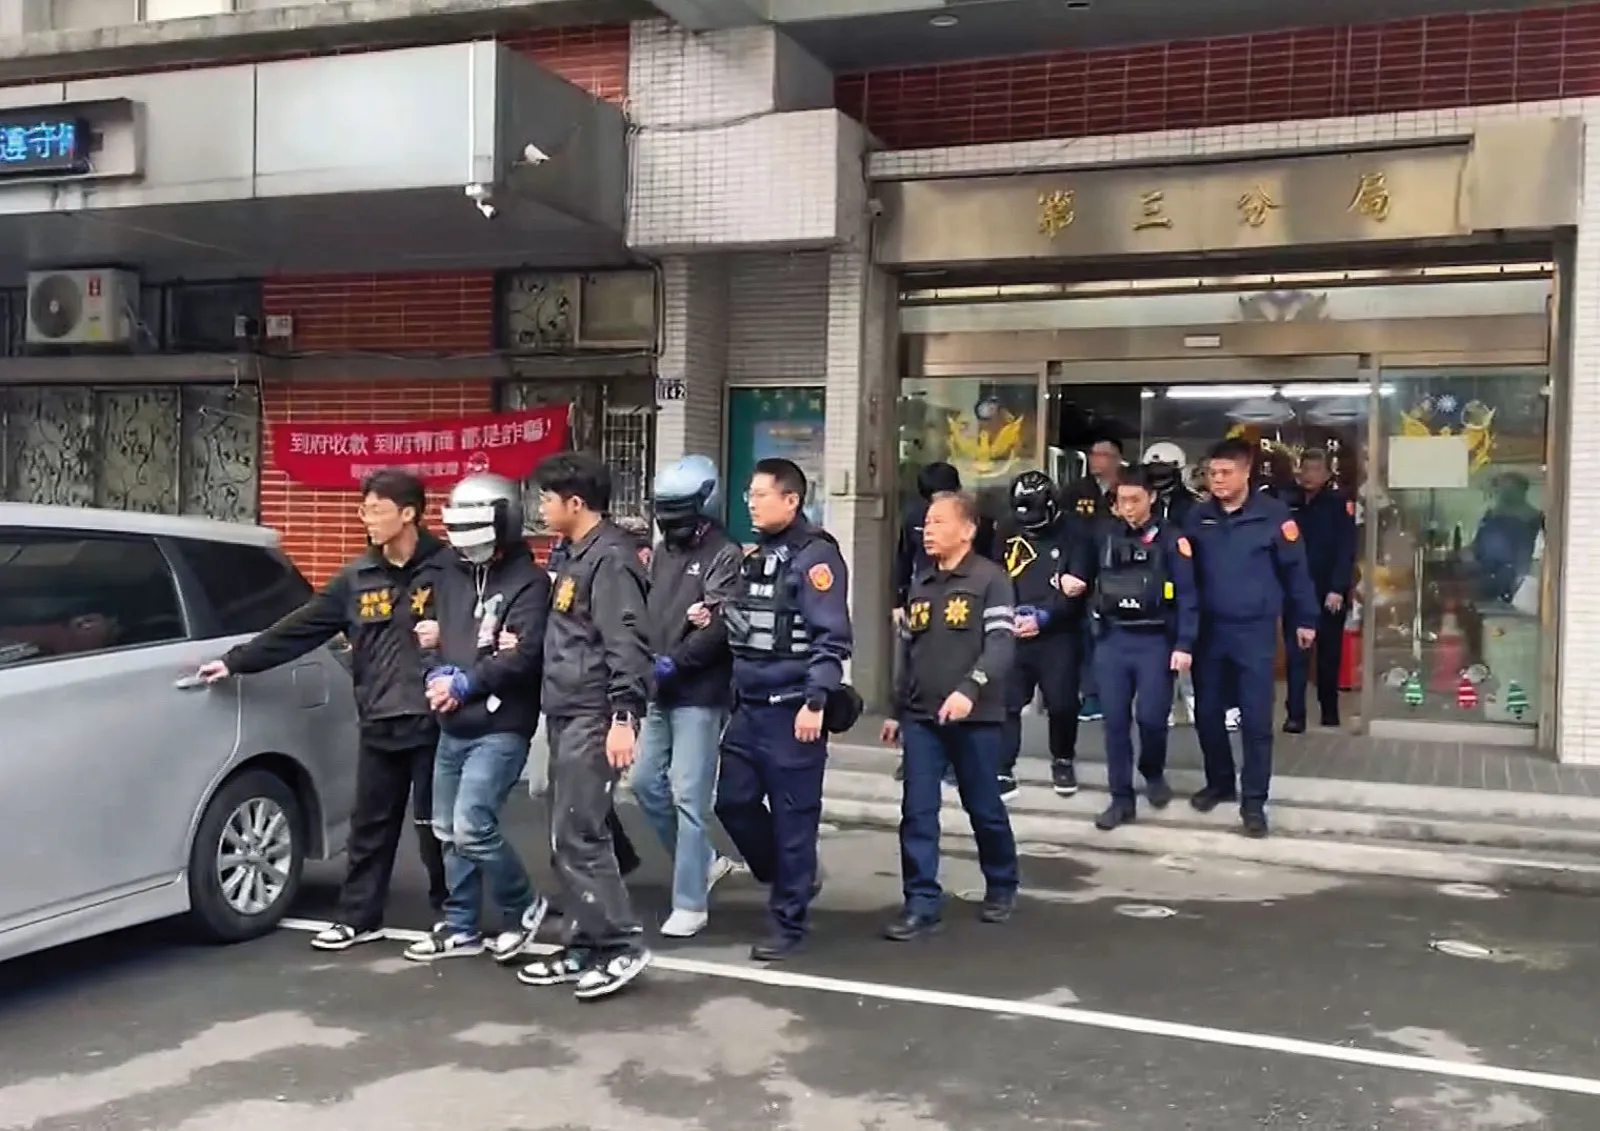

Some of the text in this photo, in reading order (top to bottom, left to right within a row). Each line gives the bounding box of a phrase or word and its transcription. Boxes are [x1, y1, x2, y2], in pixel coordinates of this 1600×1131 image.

[1038, 172, 1392, 239] 第三分局
[290, 432, 369, 456] 到府收款
